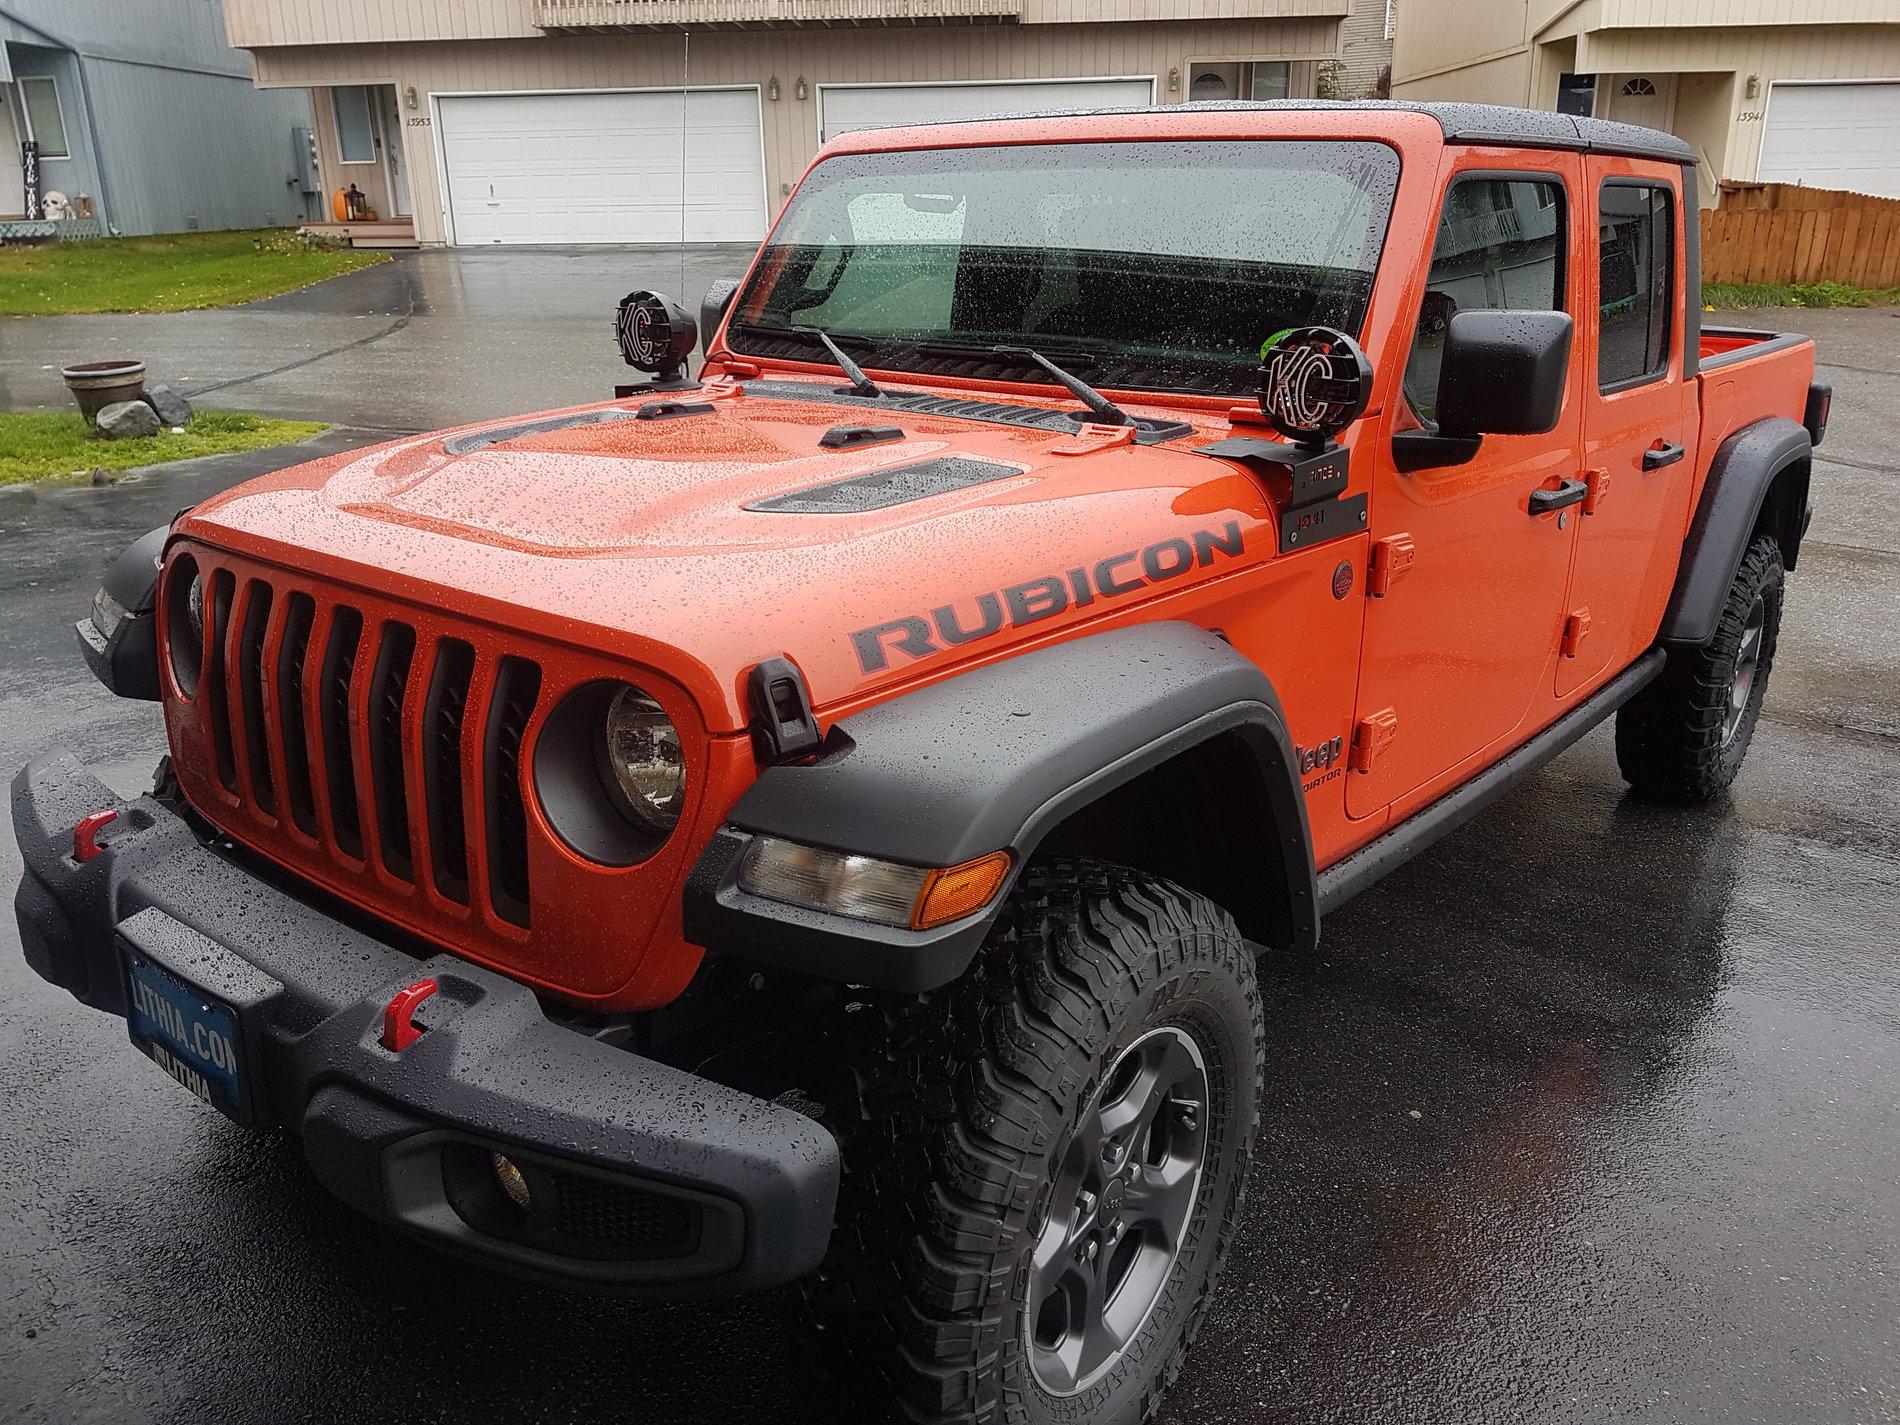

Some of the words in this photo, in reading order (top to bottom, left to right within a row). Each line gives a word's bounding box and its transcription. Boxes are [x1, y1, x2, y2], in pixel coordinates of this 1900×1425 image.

[615, 302, 653, 362] KC
[1266, 345, 1333, 428] KC
[848, 520, 1245, 676] RUBICON
[1303, 768, 1342, 793] DIATOR
[163, 1049, 212, 1106] LITHIA
